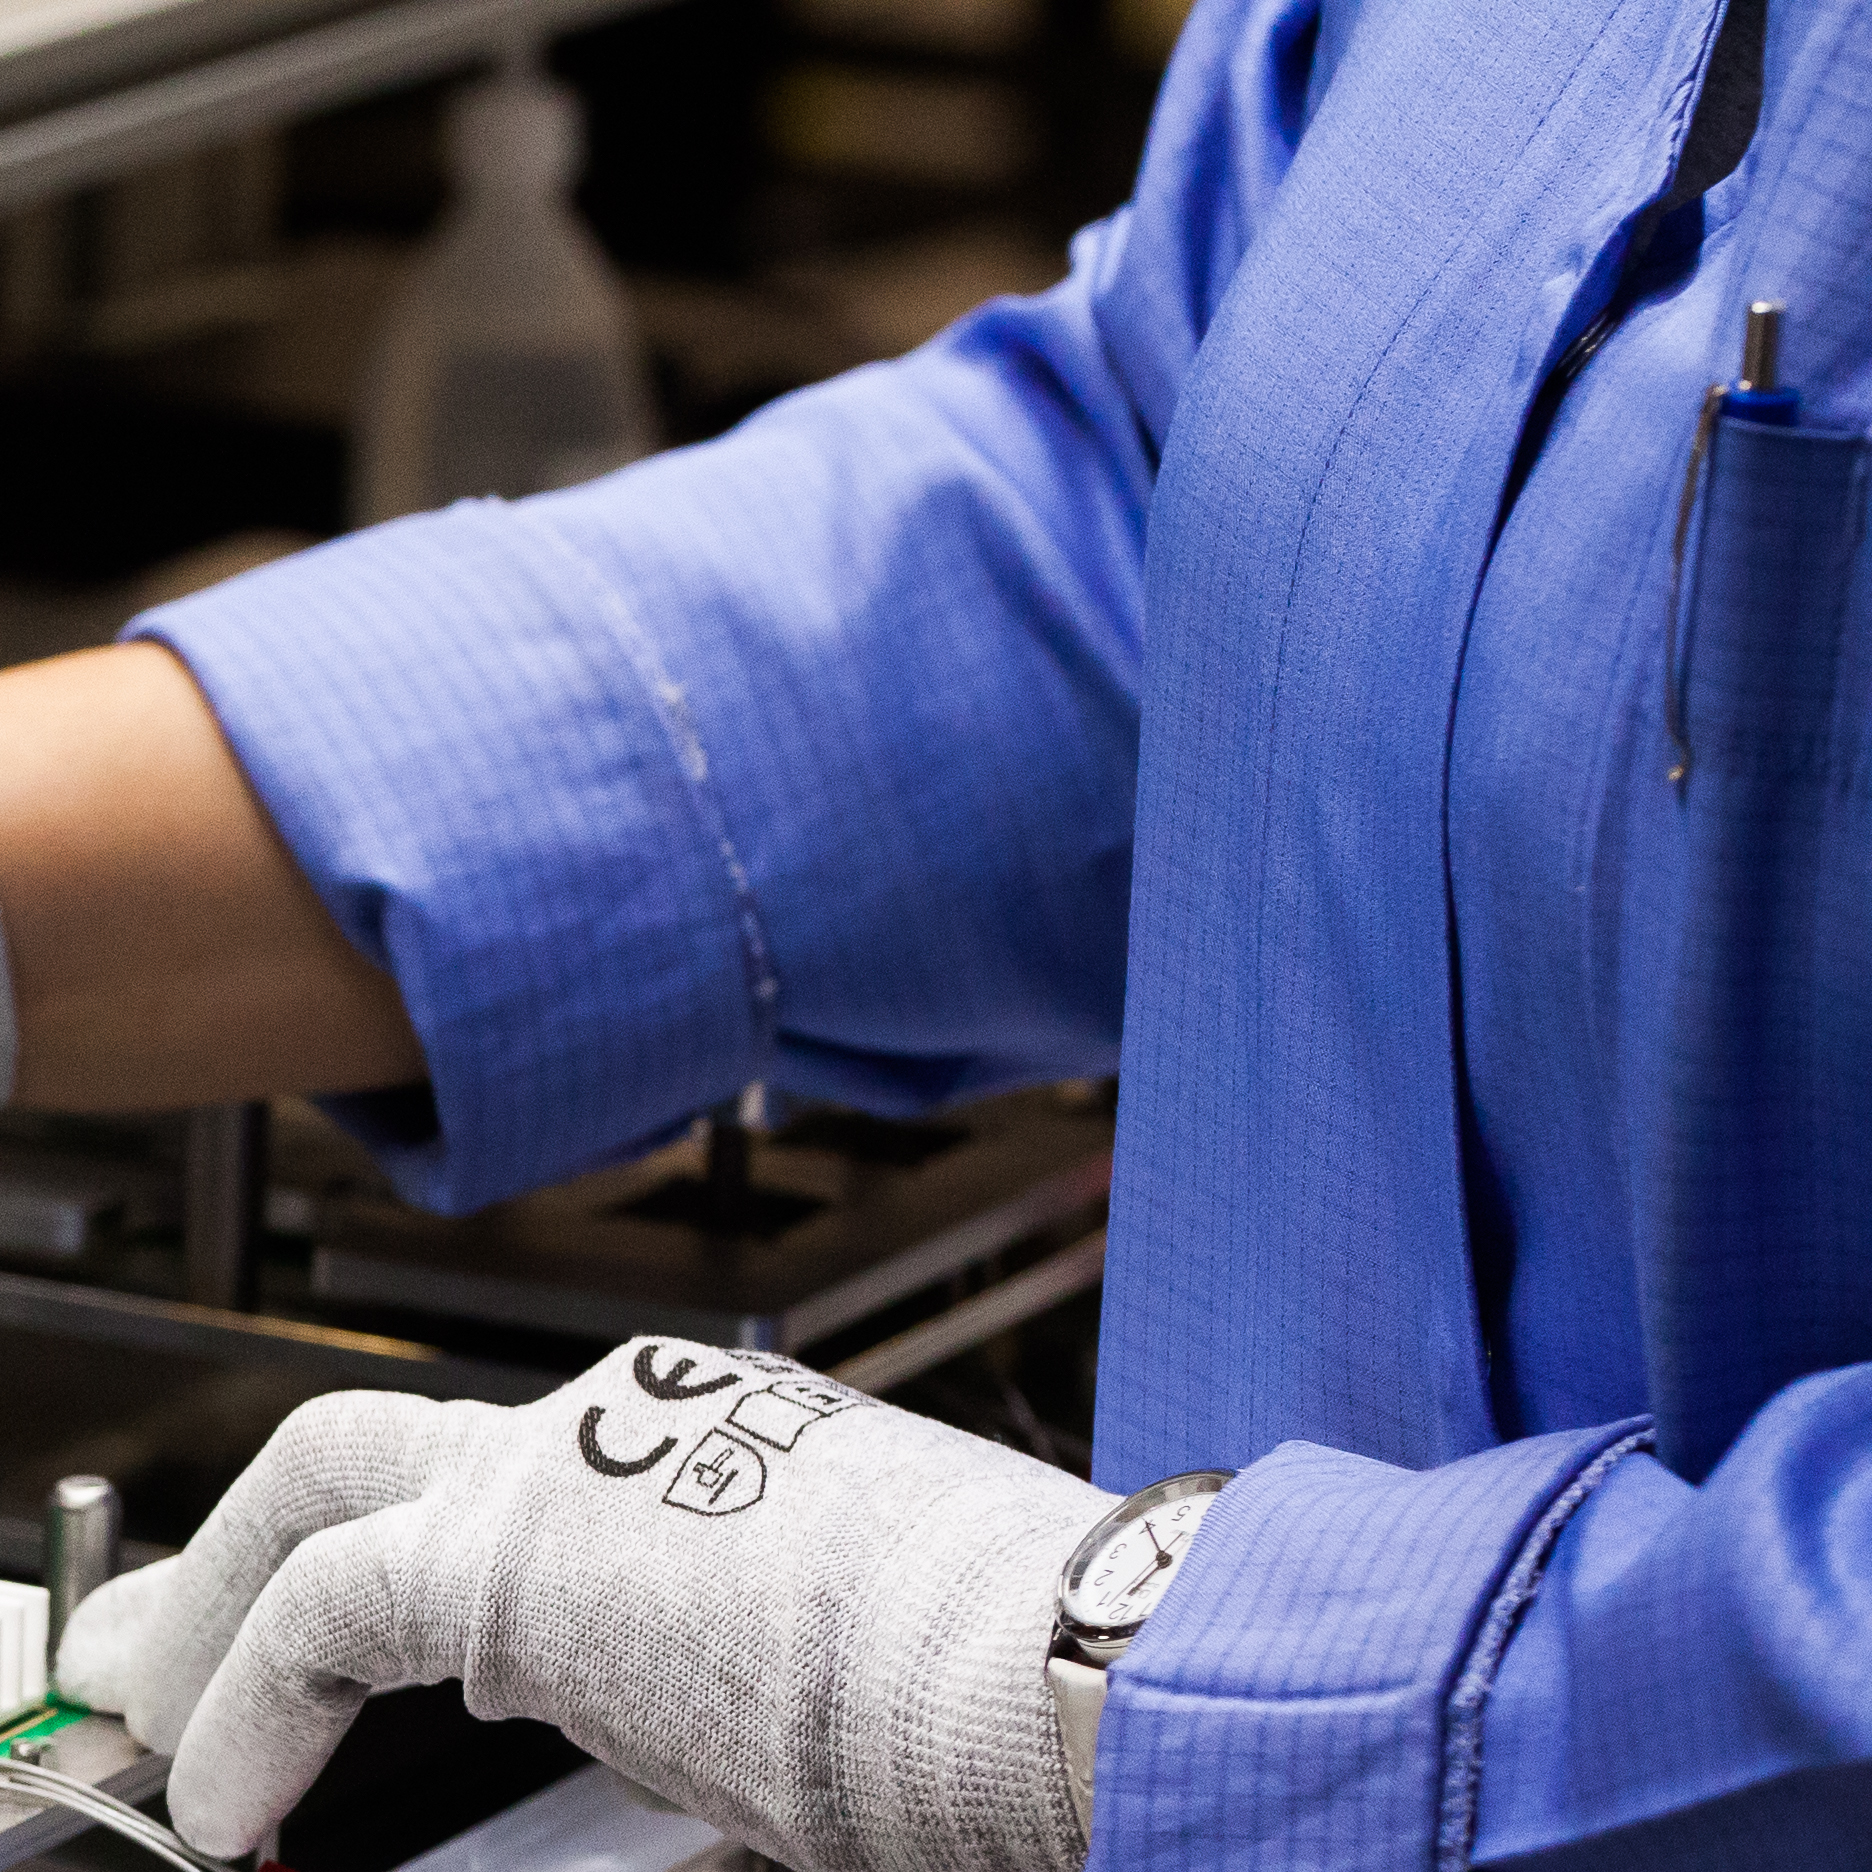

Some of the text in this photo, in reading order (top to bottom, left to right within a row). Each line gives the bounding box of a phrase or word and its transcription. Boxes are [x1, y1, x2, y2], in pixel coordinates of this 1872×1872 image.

[577, 1345, 743, 1478] CE
[1171, 1505, 1191, 1522] 5
[1108, 1543, 1127, 1560] 3
[1094, 1569, 1114, 1587] 2
[1096, 1591, 1111, 1607] 1
[1108, 1602, 1134, 1622] 12
